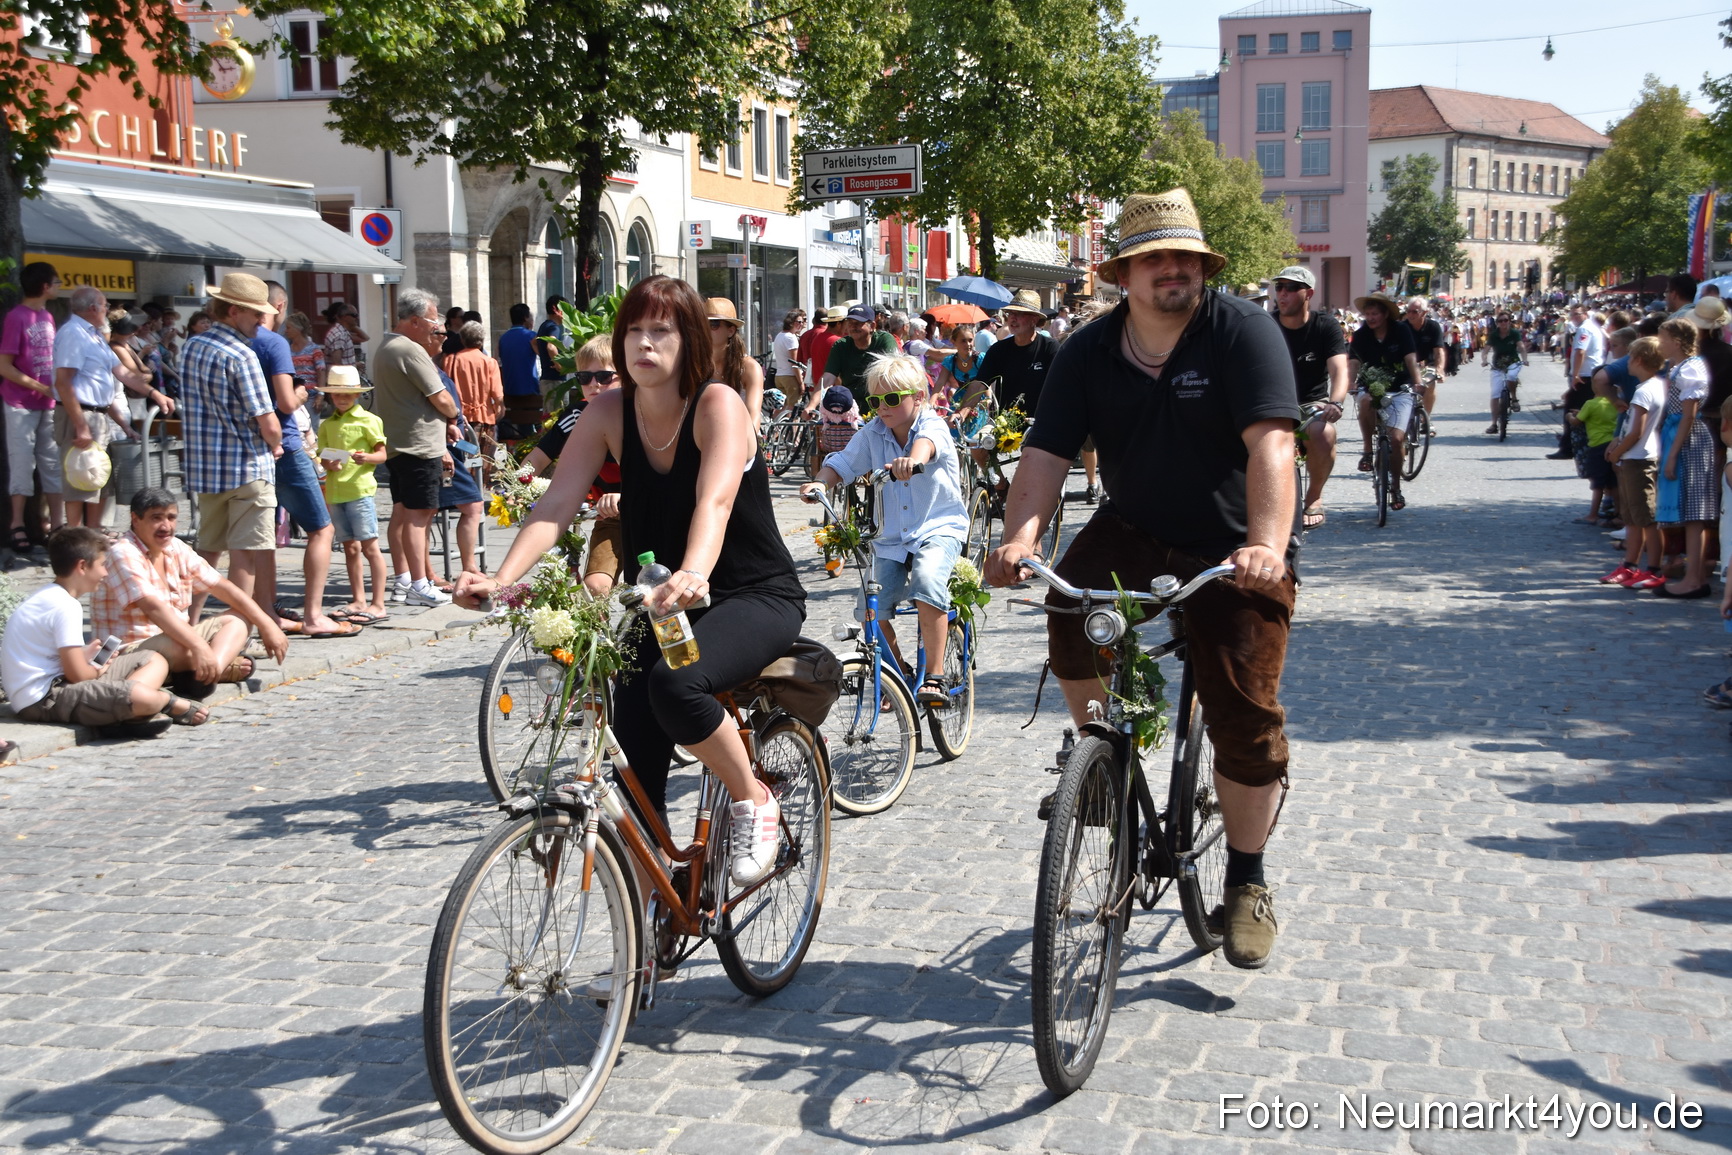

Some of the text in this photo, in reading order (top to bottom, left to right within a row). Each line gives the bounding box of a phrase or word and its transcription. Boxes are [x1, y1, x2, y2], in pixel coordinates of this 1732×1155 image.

[822, 154, 897, 170] Parkleitsystem
[849, 178, 899, 190] Rosengasse
[832, 220, 858, 231] Rosengasse
[63, 273, 135, 289] SCHLIERF
